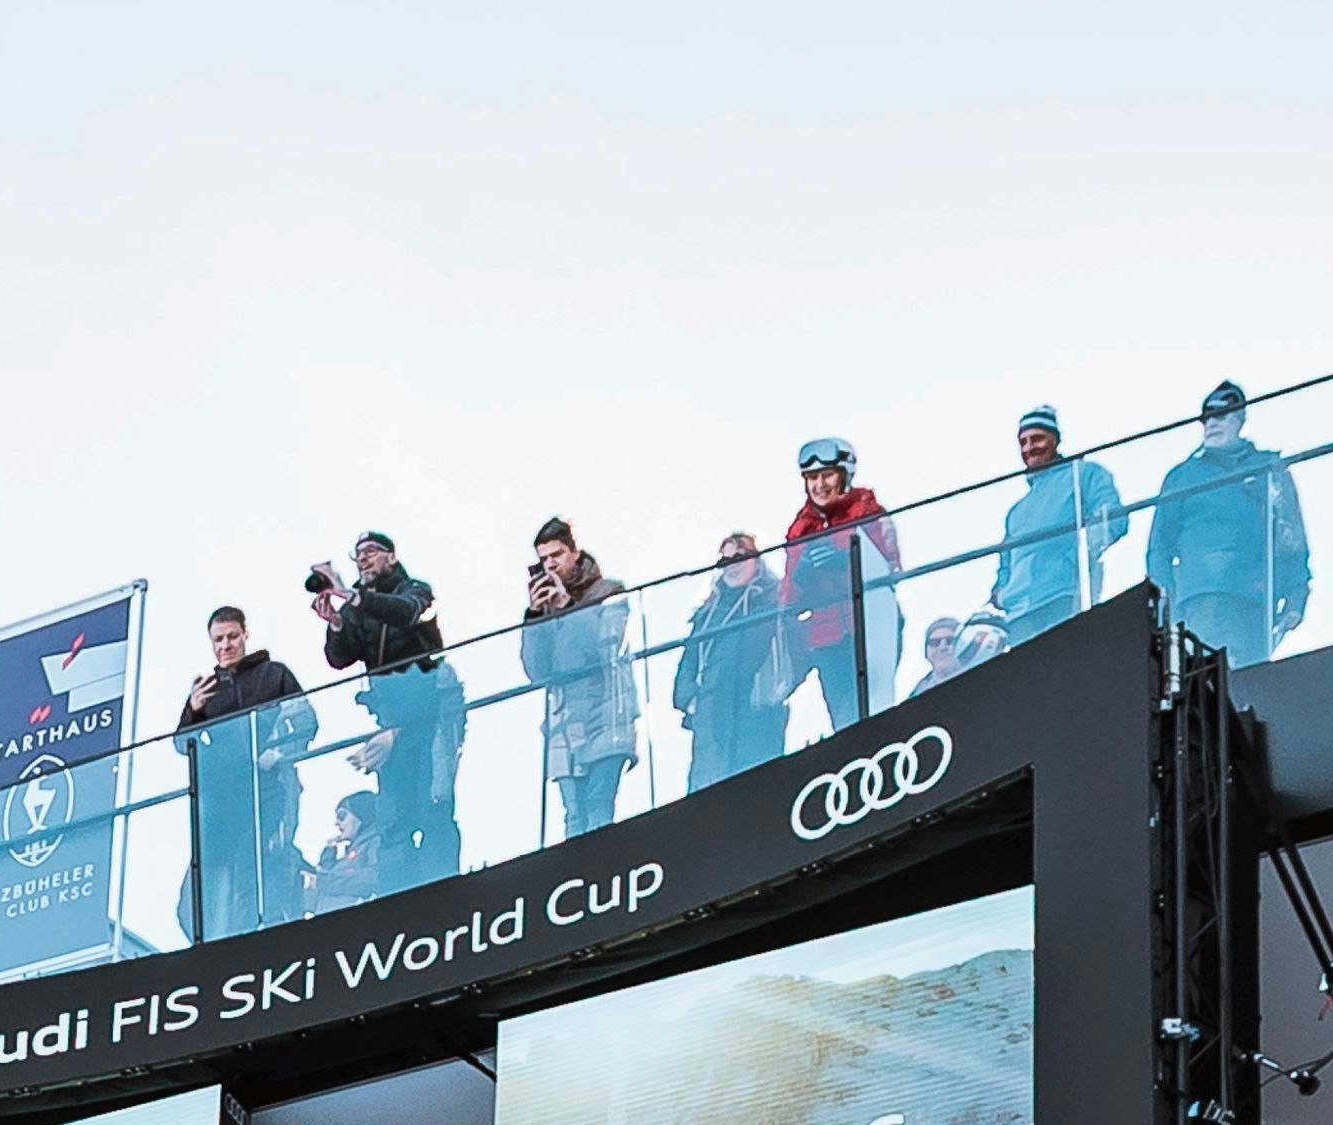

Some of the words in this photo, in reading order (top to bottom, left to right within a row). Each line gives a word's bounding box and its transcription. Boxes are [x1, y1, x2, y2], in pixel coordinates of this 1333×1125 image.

[6, 895, 50, 918] CLUB
[59, 882, 93, 904] KSC
[111, 985, 200, 1043] FIS
[335, 896, 525, 989] World
[546, 861, 665, 927] Cup
